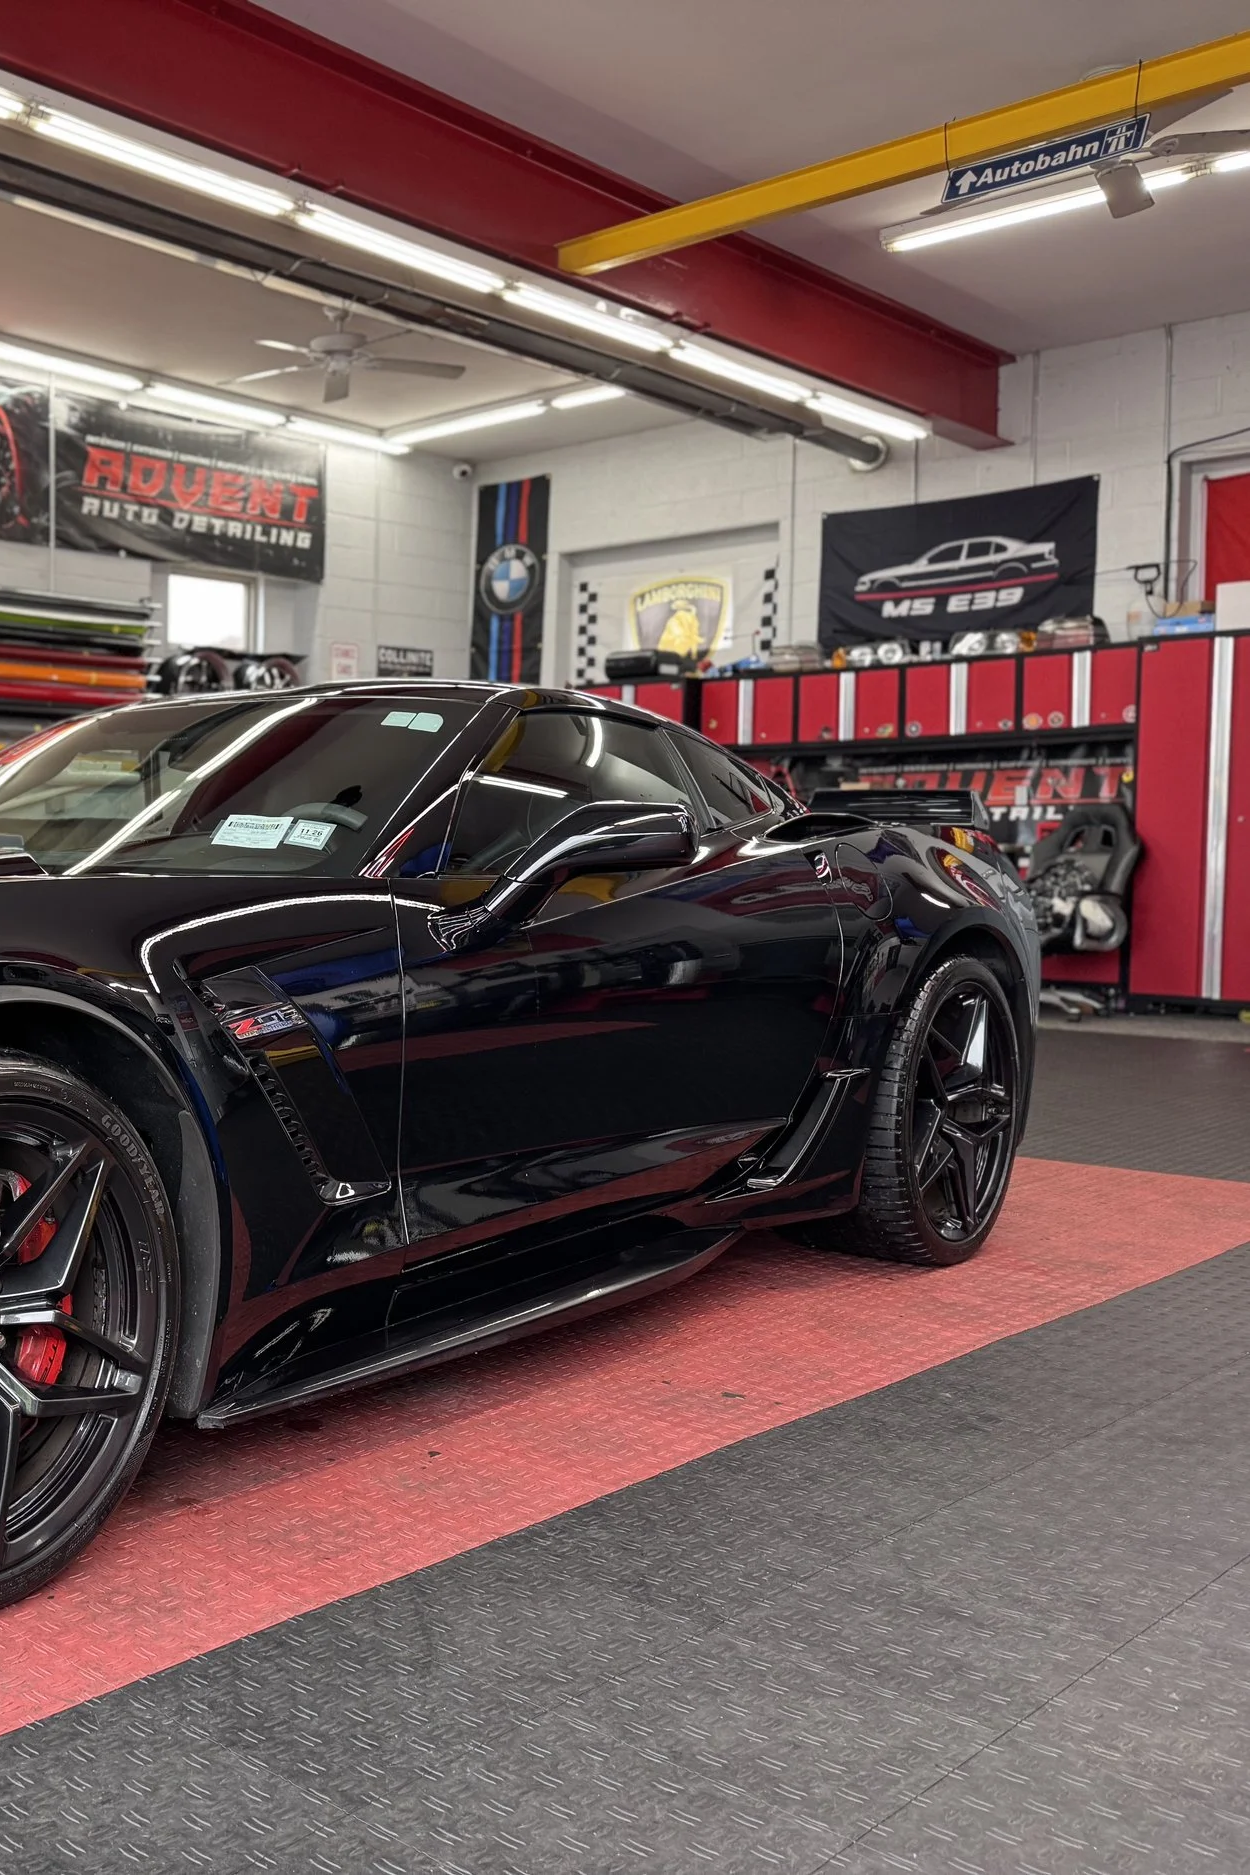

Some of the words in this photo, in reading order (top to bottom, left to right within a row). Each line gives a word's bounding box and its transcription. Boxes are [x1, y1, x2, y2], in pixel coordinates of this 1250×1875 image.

[975, 141, 1100, 187] Autobahn
[82, 444, 319, 523] ADVENT
[81, 496, 159, 525] AUTO
[172, 511, 313, 549] DETAILING
[946, 586, 1024, 613] E39
[101, 1114, 166, 1217] GOODYEAR
